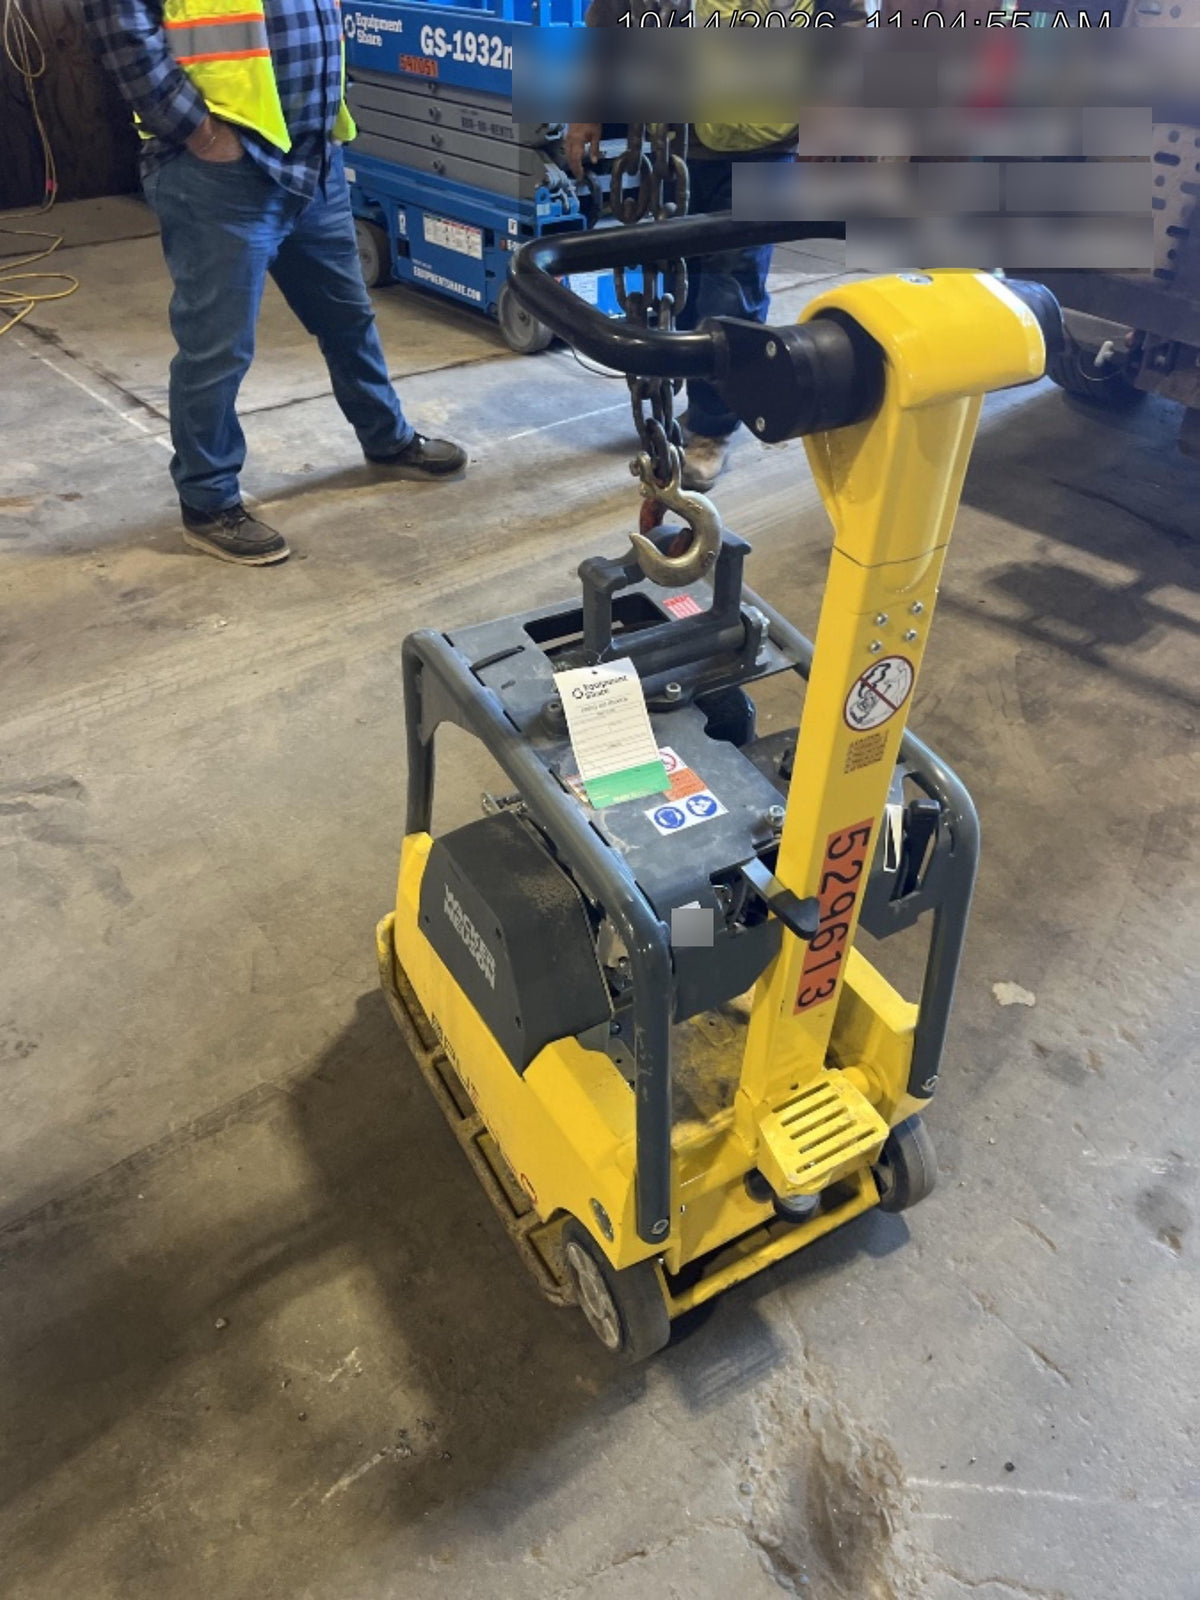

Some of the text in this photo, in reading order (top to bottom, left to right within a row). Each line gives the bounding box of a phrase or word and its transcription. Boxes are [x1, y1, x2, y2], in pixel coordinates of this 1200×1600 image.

[355, 12, 403, 33] Equipment
[357, 29, 382, 47] Share
[798, 826, 871, 1008] 529613
